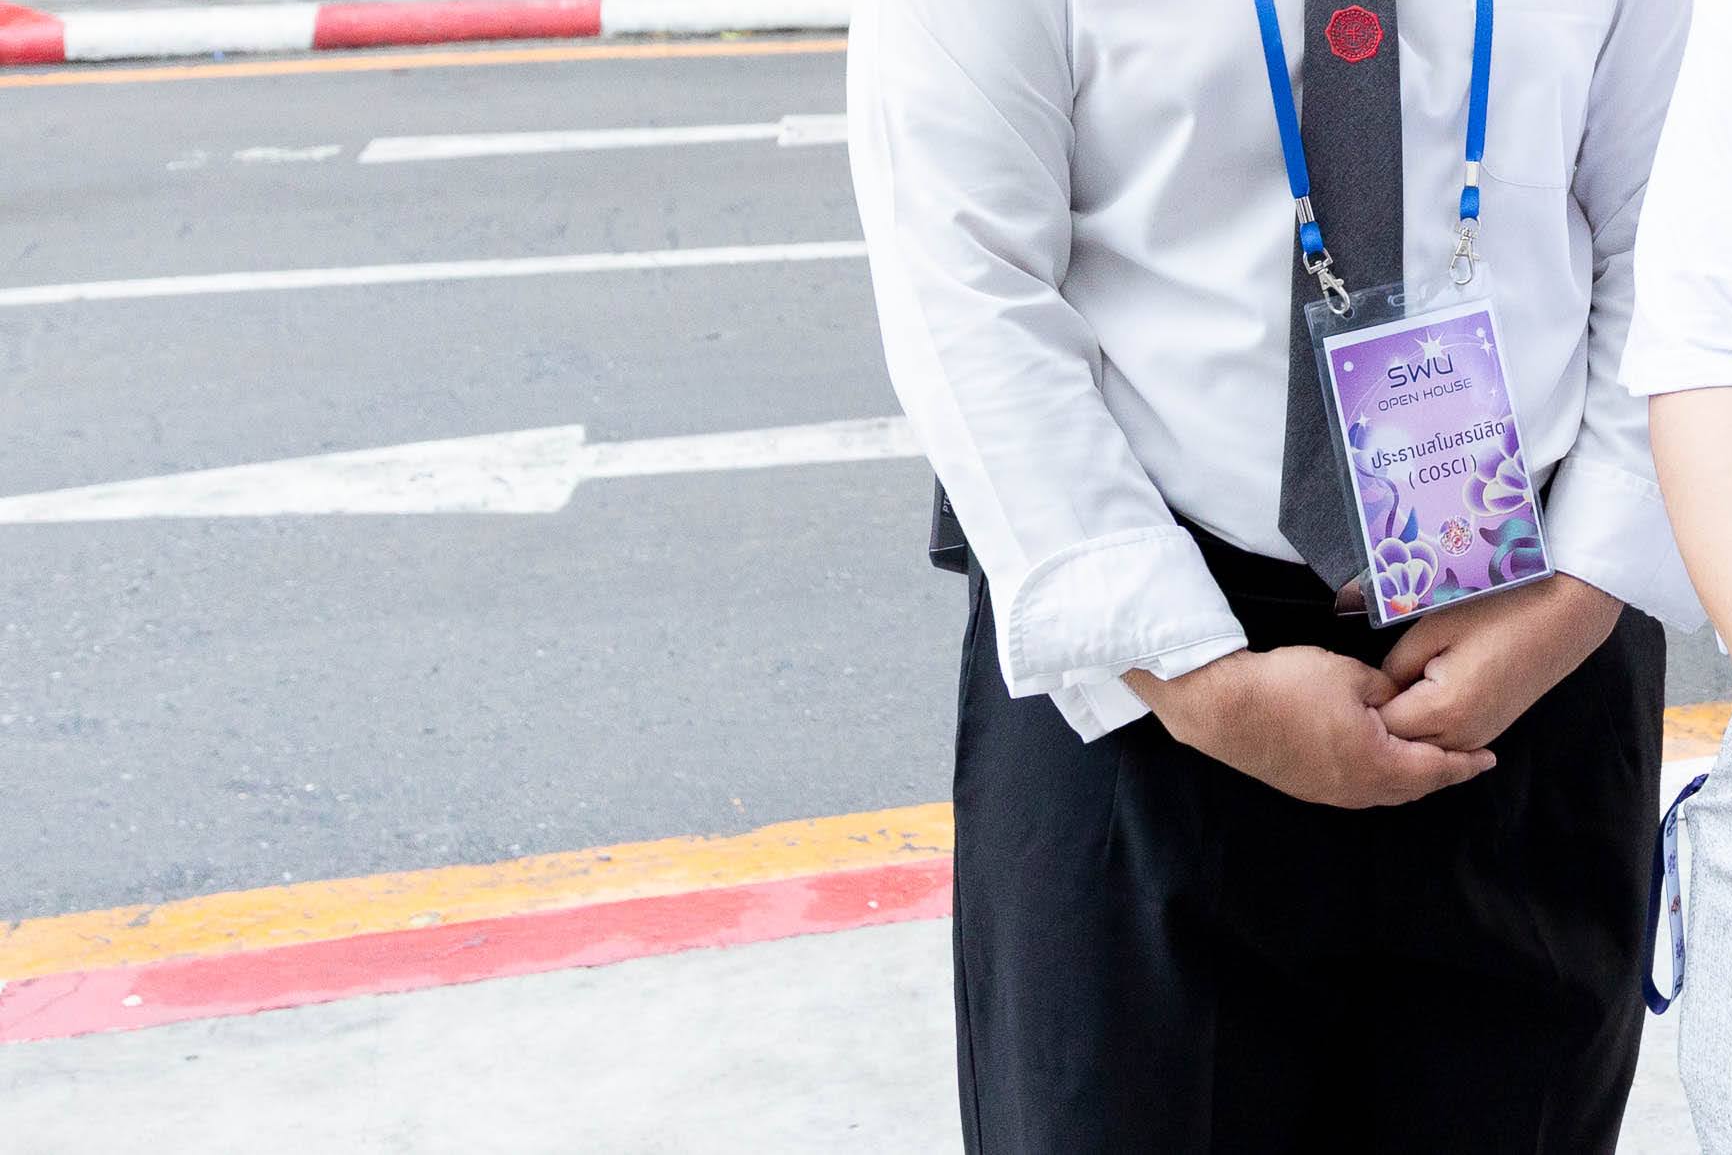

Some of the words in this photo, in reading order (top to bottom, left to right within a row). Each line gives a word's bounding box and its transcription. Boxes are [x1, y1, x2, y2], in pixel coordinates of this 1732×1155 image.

[1387, 354, 1454, 389] SWU
[1378, 392, 1419, 412] OPEN
[1422, 377, 1472, 400] HOUSE
[1371, 420, 1506, 469] ประธานสโมสรนิสิต
